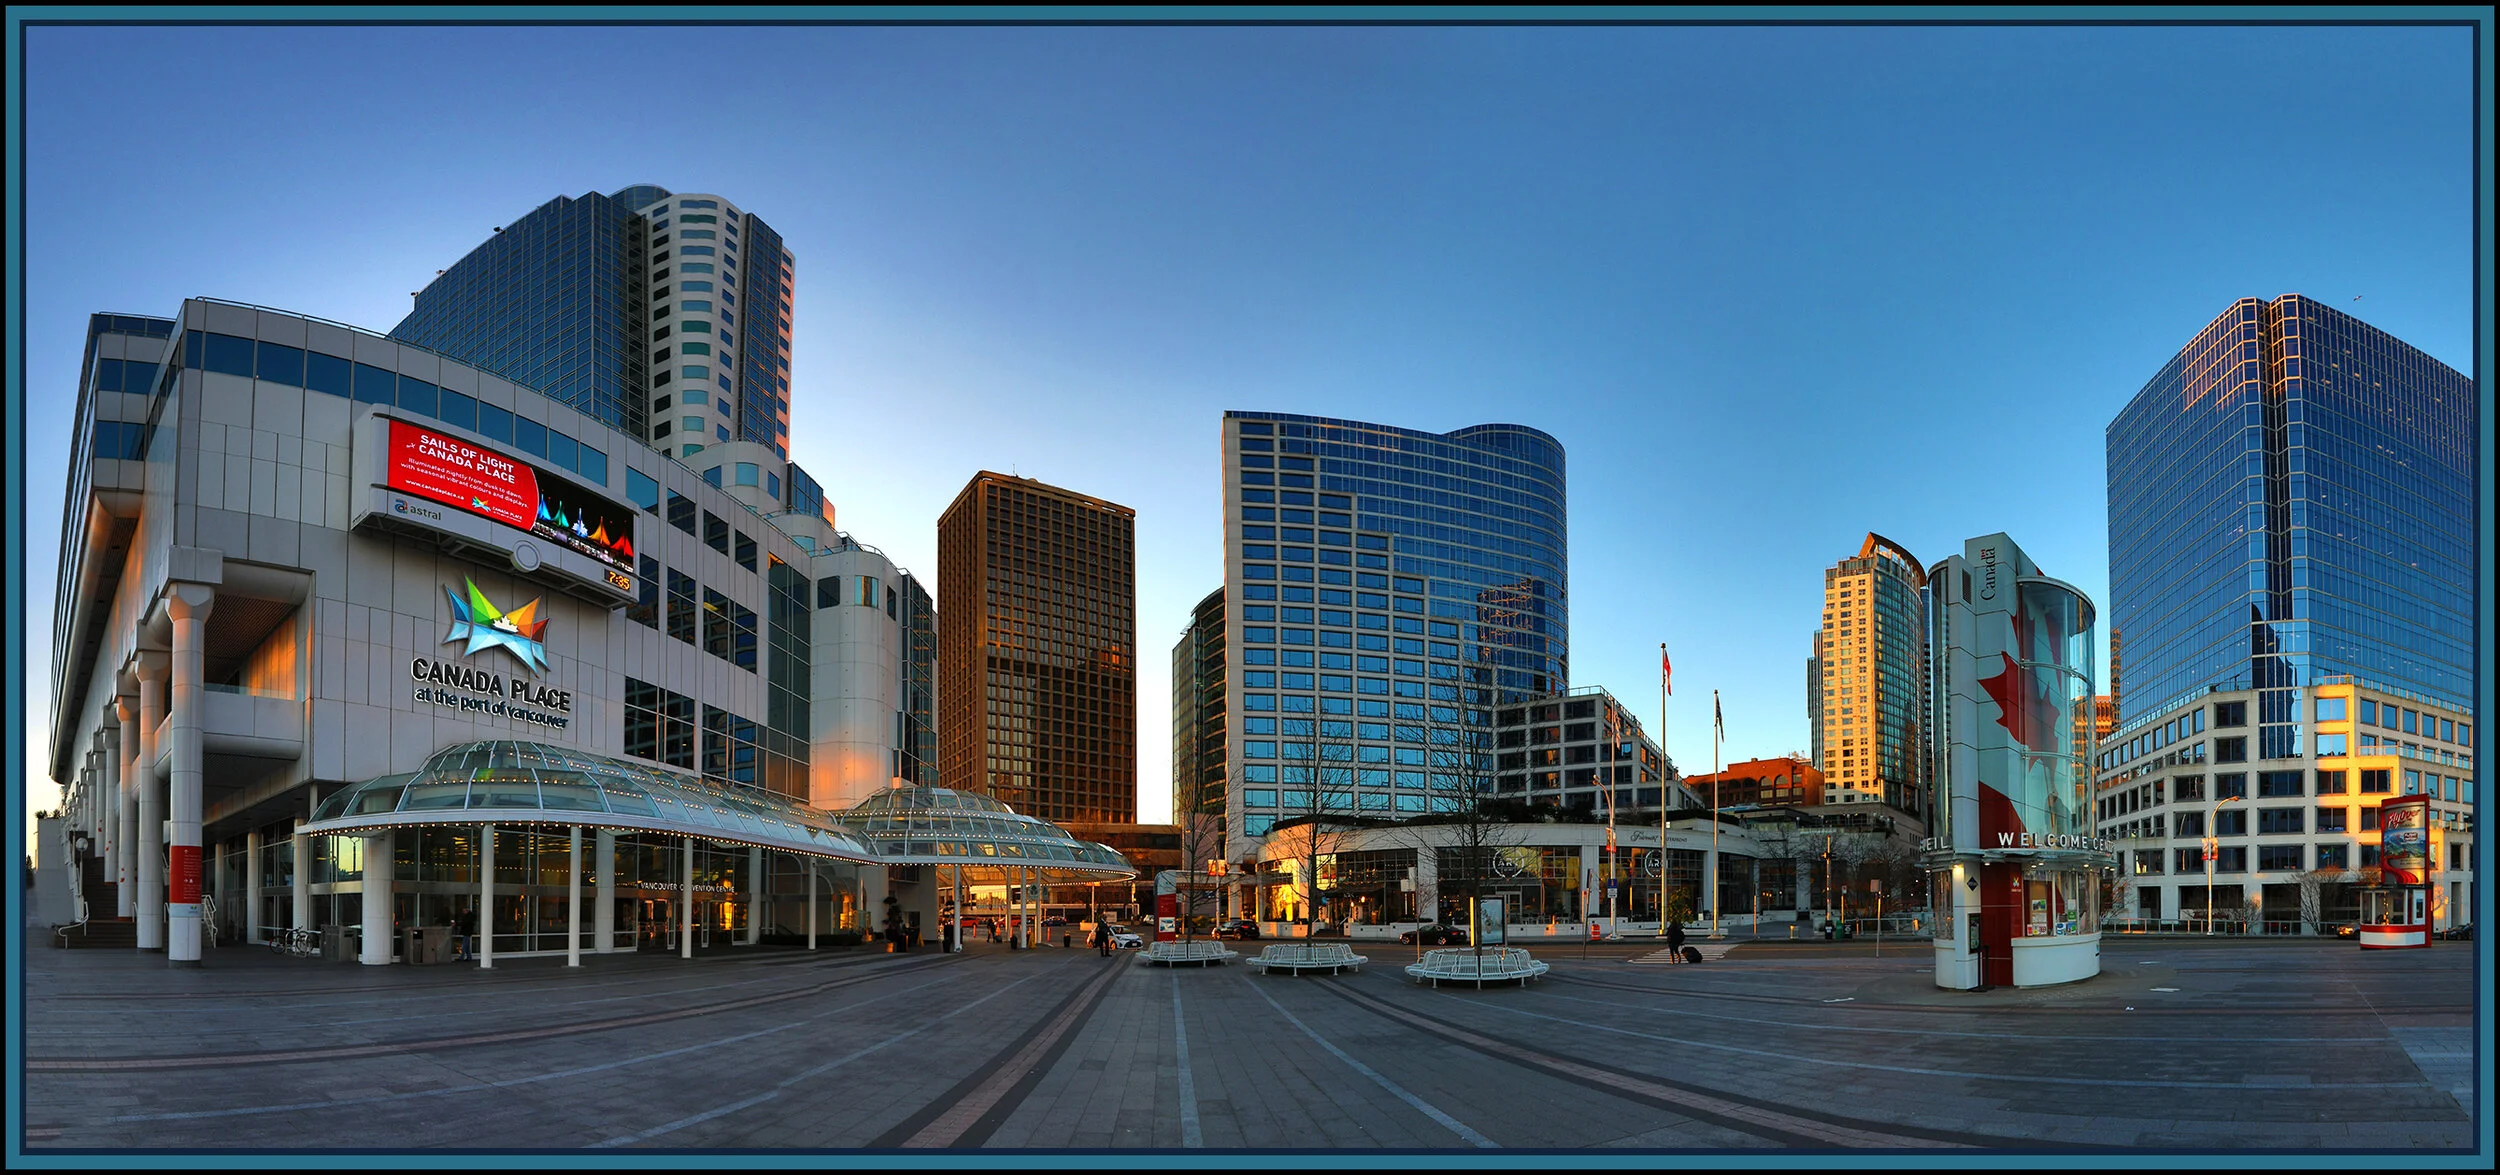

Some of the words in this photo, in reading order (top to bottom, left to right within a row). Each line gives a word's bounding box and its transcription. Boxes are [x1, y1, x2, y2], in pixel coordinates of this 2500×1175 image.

[418, 444, 473, 469] CANADA
[476, 463, 516, 484] PLACE
[420, 434, 458, 453] SAILS
[461, 448, 477, 459] OF
[480, 453, 514, 473] LIGHT
[400, 462, 416, 471] with
[416, 466, 446, 480] seasonal
[446, 476, 469, 488] vibrant
[469, 483, 492, 496] colours
[492, 490, 504, 499] and
[408, 457, 445, 473] Illuminated
[446, 469, 468, 481] nightly
[468, 476, 483, 486] from
[405, 479, 465, 500] www.canadaplace.ca
[410, 505, 442, 521] astral
[609, 571, 630, 590] 7:35
[1980, 546, 1996, 600] Canada
[411, 657, 504, 697] CANADA
[510, 679, 571, 713] PLACE
[414, 687, 432, 703] at
[433, 688, 458, 707] the
[459, 694, 491, 713] port
[491, 700, 506, 716] of
[507, 705, 569, 729] vancouver
[1998, 832, 2088, 849] WELCOME
[640, 881, 678, 891] VANCOUVER
[679, 883, 715, 892] CVENTION
